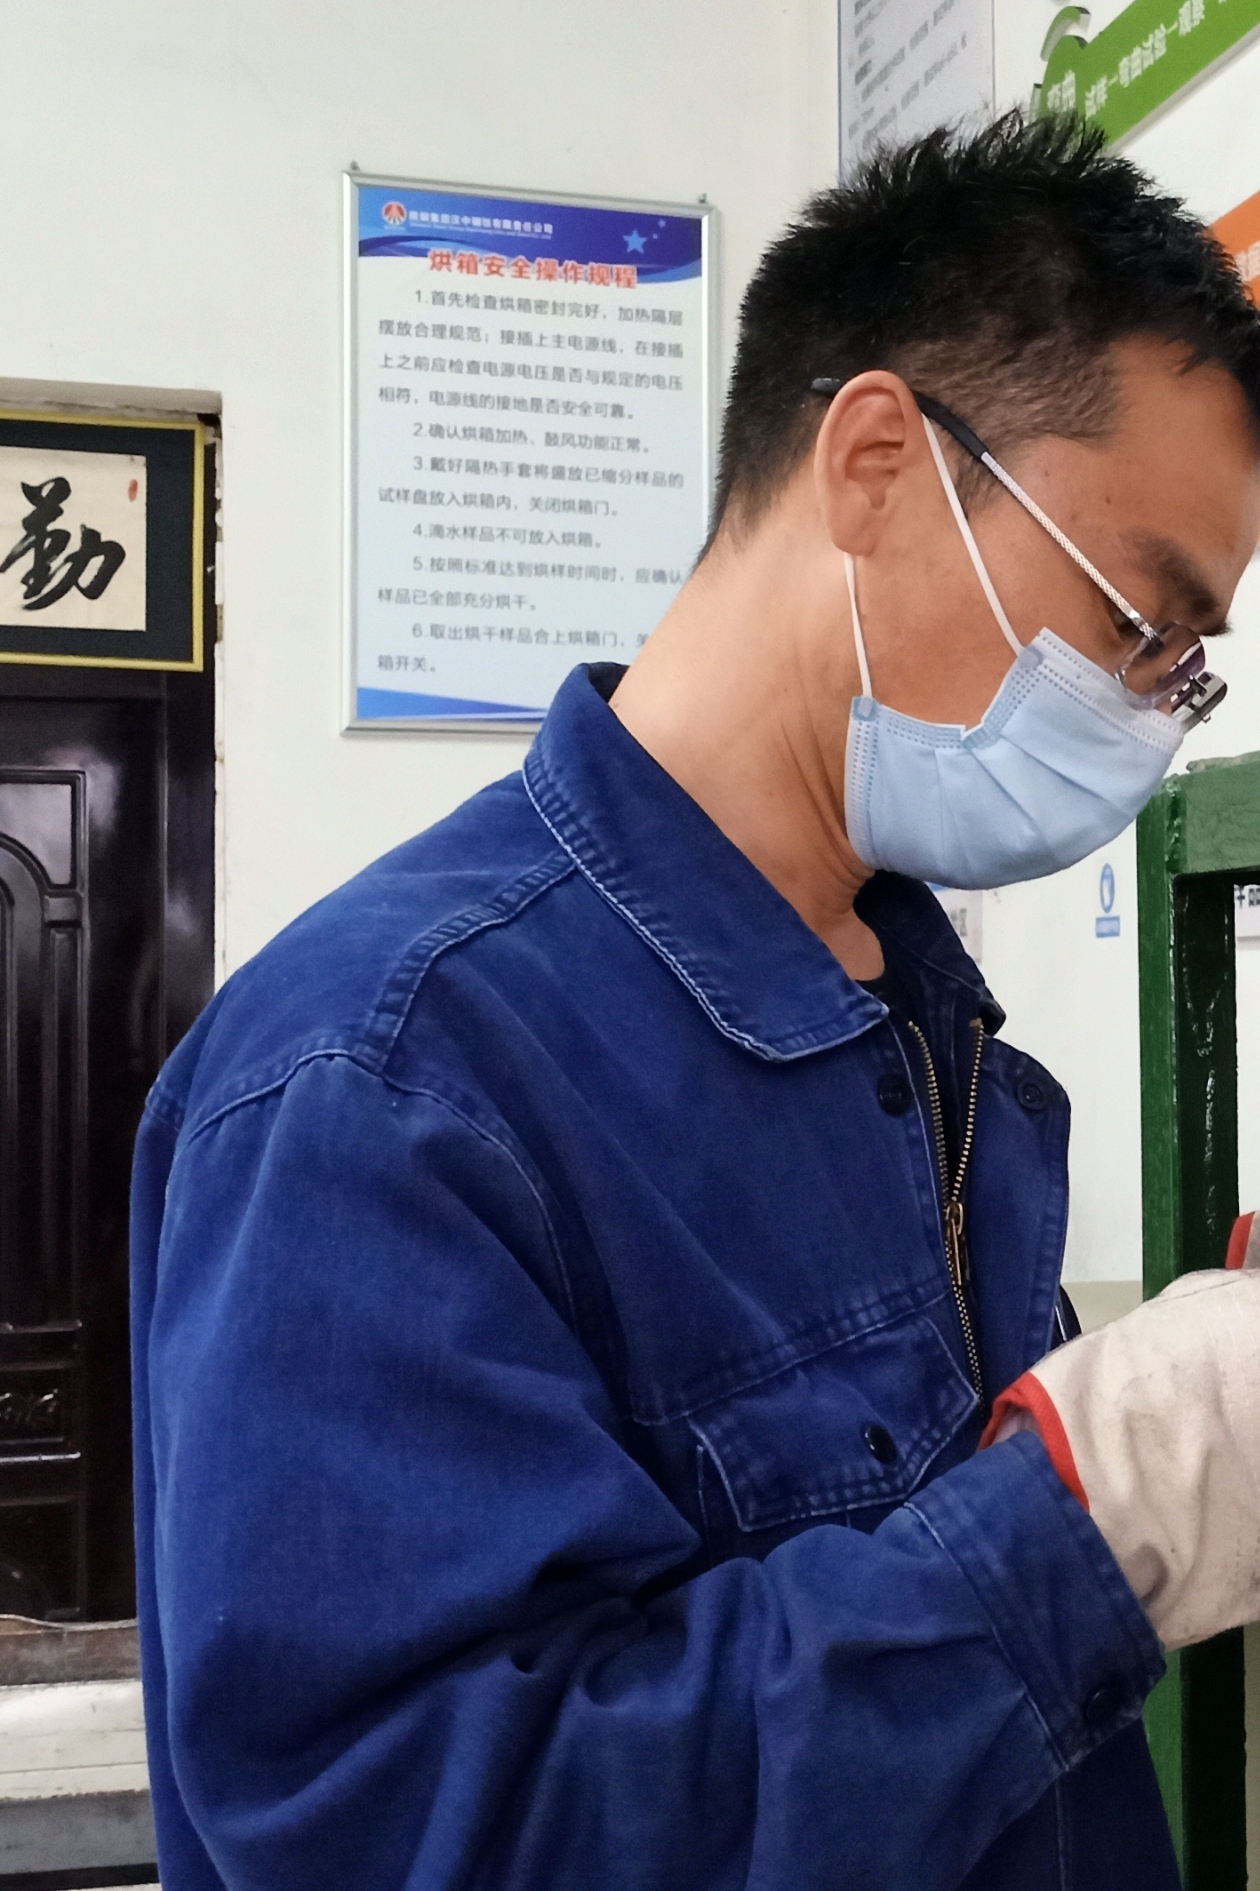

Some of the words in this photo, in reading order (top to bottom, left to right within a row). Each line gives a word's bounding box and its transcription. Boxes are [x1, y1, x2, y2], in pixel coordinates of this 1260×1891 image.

[428, 249, 637, 289] 烘箱安全操作规程
[379, 353, 684, 391] 上之前应检查电源电压是否与规定的电压
[377, 587, 536, 611] 样品已全部充分烘干。
[377, 654, 436, 673] 箱开关。
